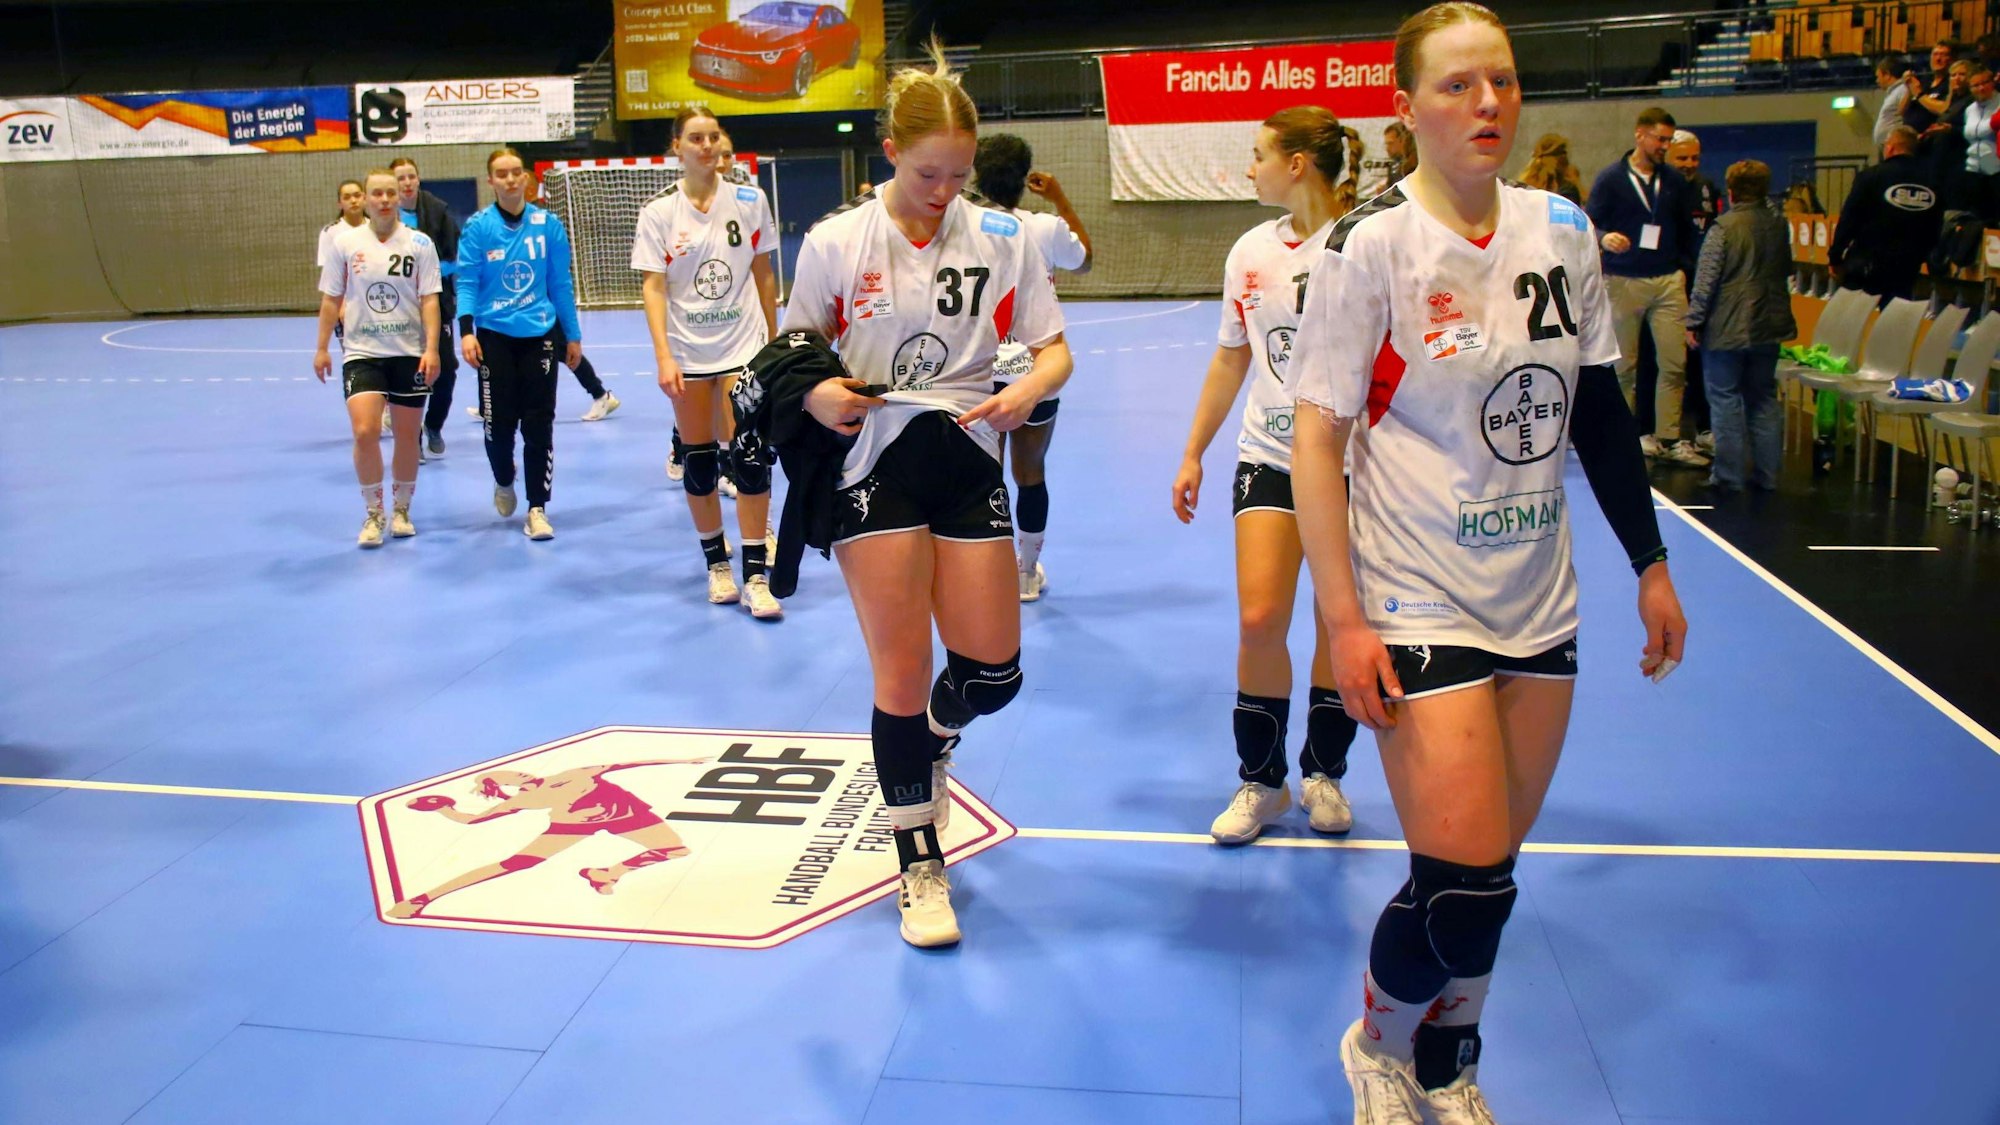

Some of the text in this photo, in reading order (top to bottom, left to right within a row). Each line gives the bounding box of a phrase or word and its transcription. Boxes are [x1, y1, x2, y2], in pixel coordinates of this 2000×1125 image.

[624, 6, 662, 18] Concept
[664, 4, 685, 16] CLA
[1166, 61, 1251, 92] Fanclub
[1260, 59, 1316, 90] Alles
[424, 82, 540, 102] ANDERS
[232, 103, 305, 124] Die Energie
[628, 103, 649, 111] THE
[685, 99, 709, 108] WAY
[8, 123, 54, 145] zev
[234, 120, 304, 139] der Region
[725, 220, 742, 247] 8
[524, 235, 546, 260] 11
[388, 254, 415, 278] 26
[697, 275, 730, 286] BAYER
[936, 267, 990, 317] 37
[1513, 265, 1578, 342] 20
[687, 309, 741, 324] HOFMANN
[1430, 310, 1464, 324] hummel
[1456, 332, 1478, 341] Bayer
[1488, 401, 1563, 432] BAYER
[1517, 373, 1534, 457] BAYER
[665, 742, 846, 826] HBF
[771, 832, 849, 906] HANDBALL
